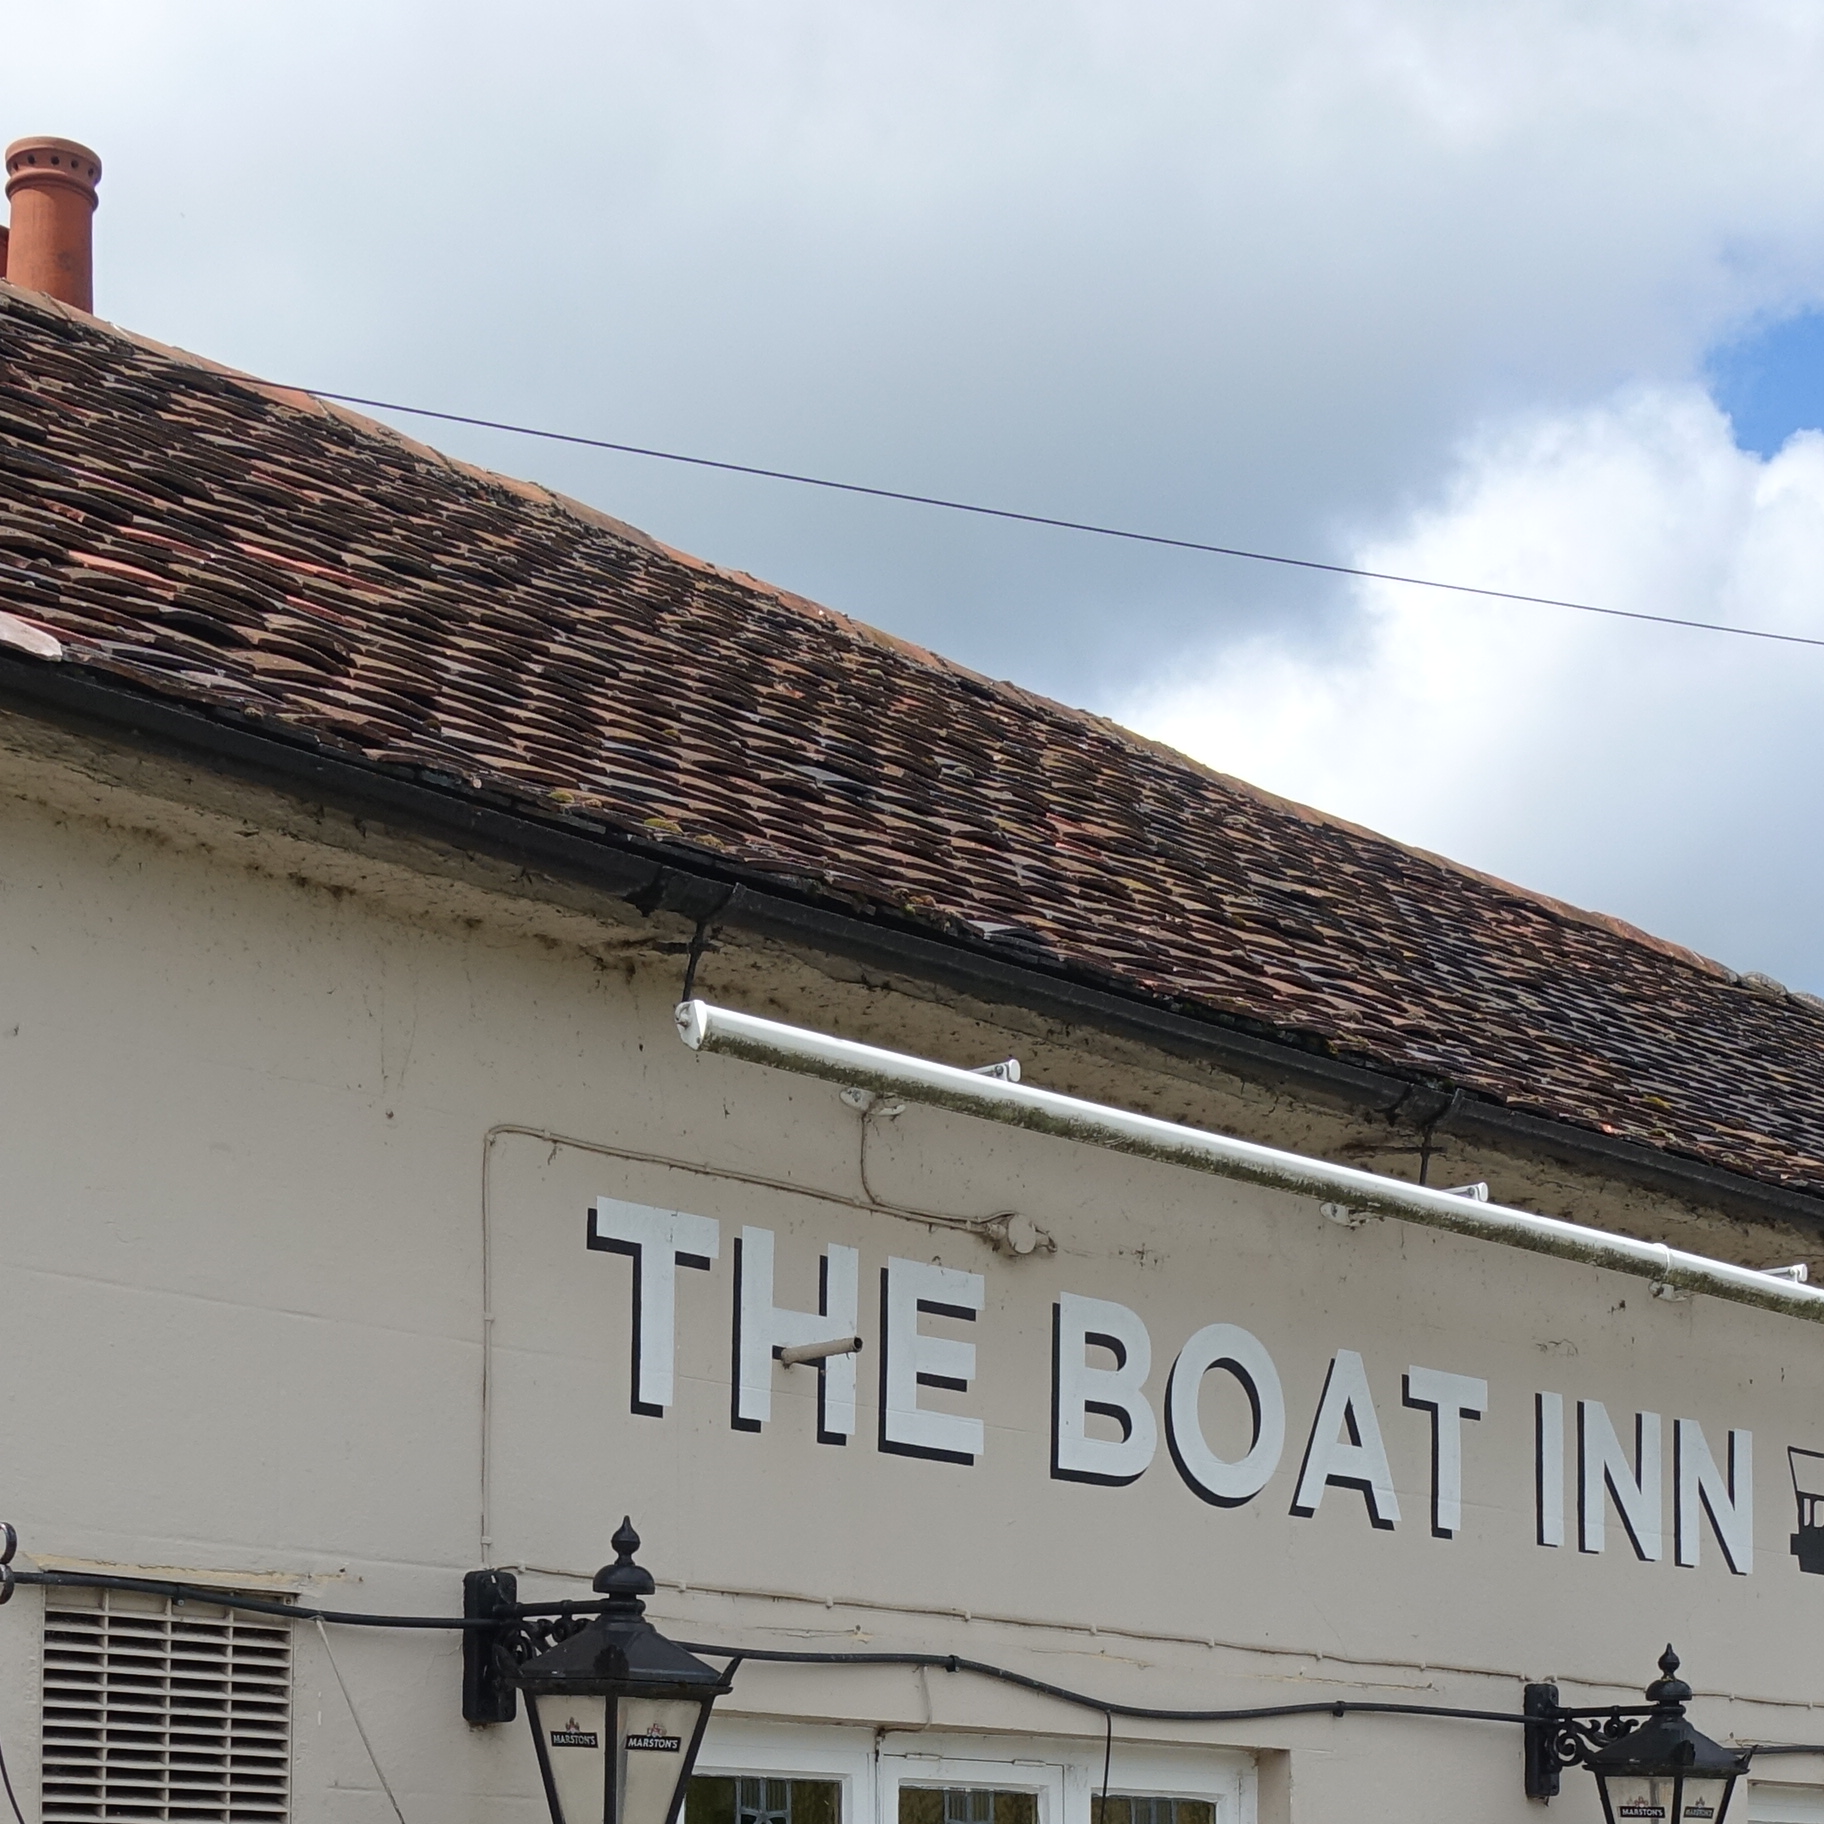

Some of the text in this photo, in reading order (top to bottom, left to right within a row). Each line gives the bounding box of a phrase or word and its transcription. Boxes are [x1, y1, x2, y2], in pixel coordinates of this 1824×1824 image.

[587, 1196, 1754, 1576] THE BOAT INN
[552, 1733, 596, 1747] MARSTON'S
[627, 1737, 679, 1749] MARSTON'S
[1621, 1807, 1664, 1817] MARSTON'S
